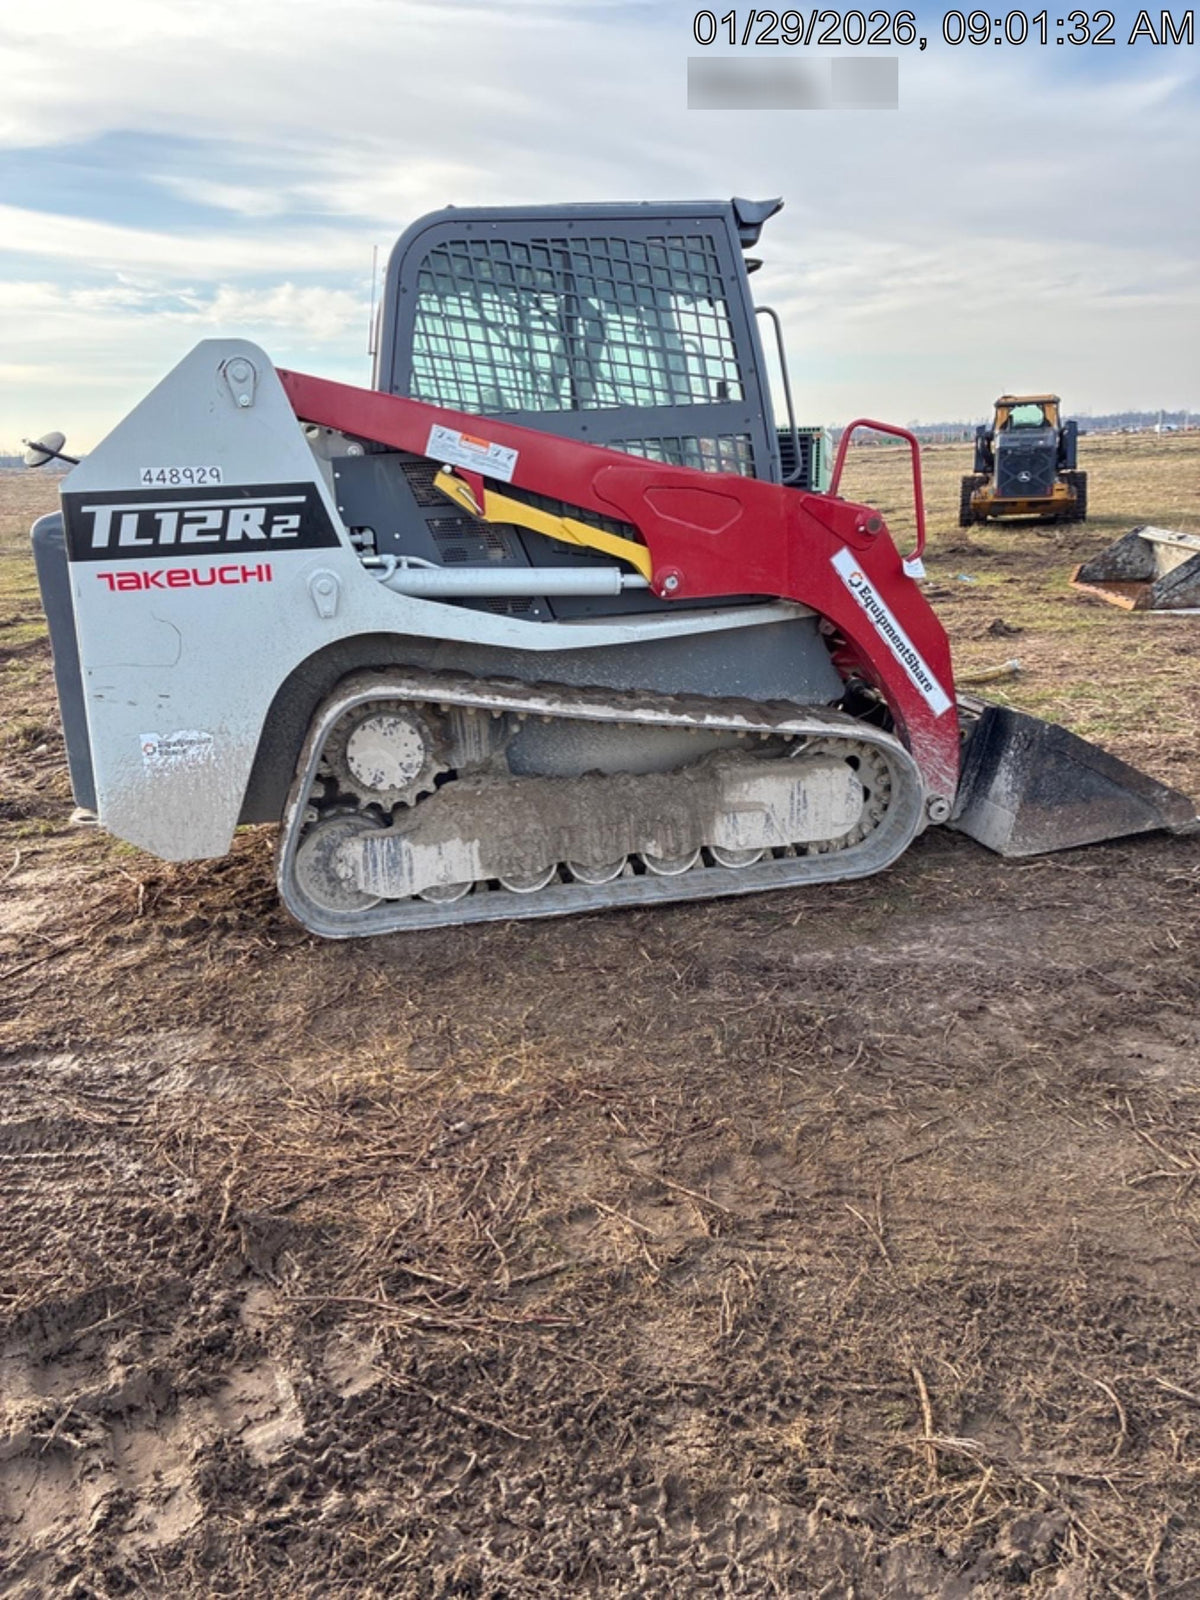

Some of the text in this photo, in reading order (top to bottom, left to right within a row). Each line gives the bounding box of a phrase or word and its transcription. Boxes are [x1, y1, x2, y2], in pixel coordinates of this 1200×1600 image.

[142, 467, 221, 484] 448929
[81, 496, 306, 548] TL12R2
[858, 585, 933, 693] EquipmentShare
